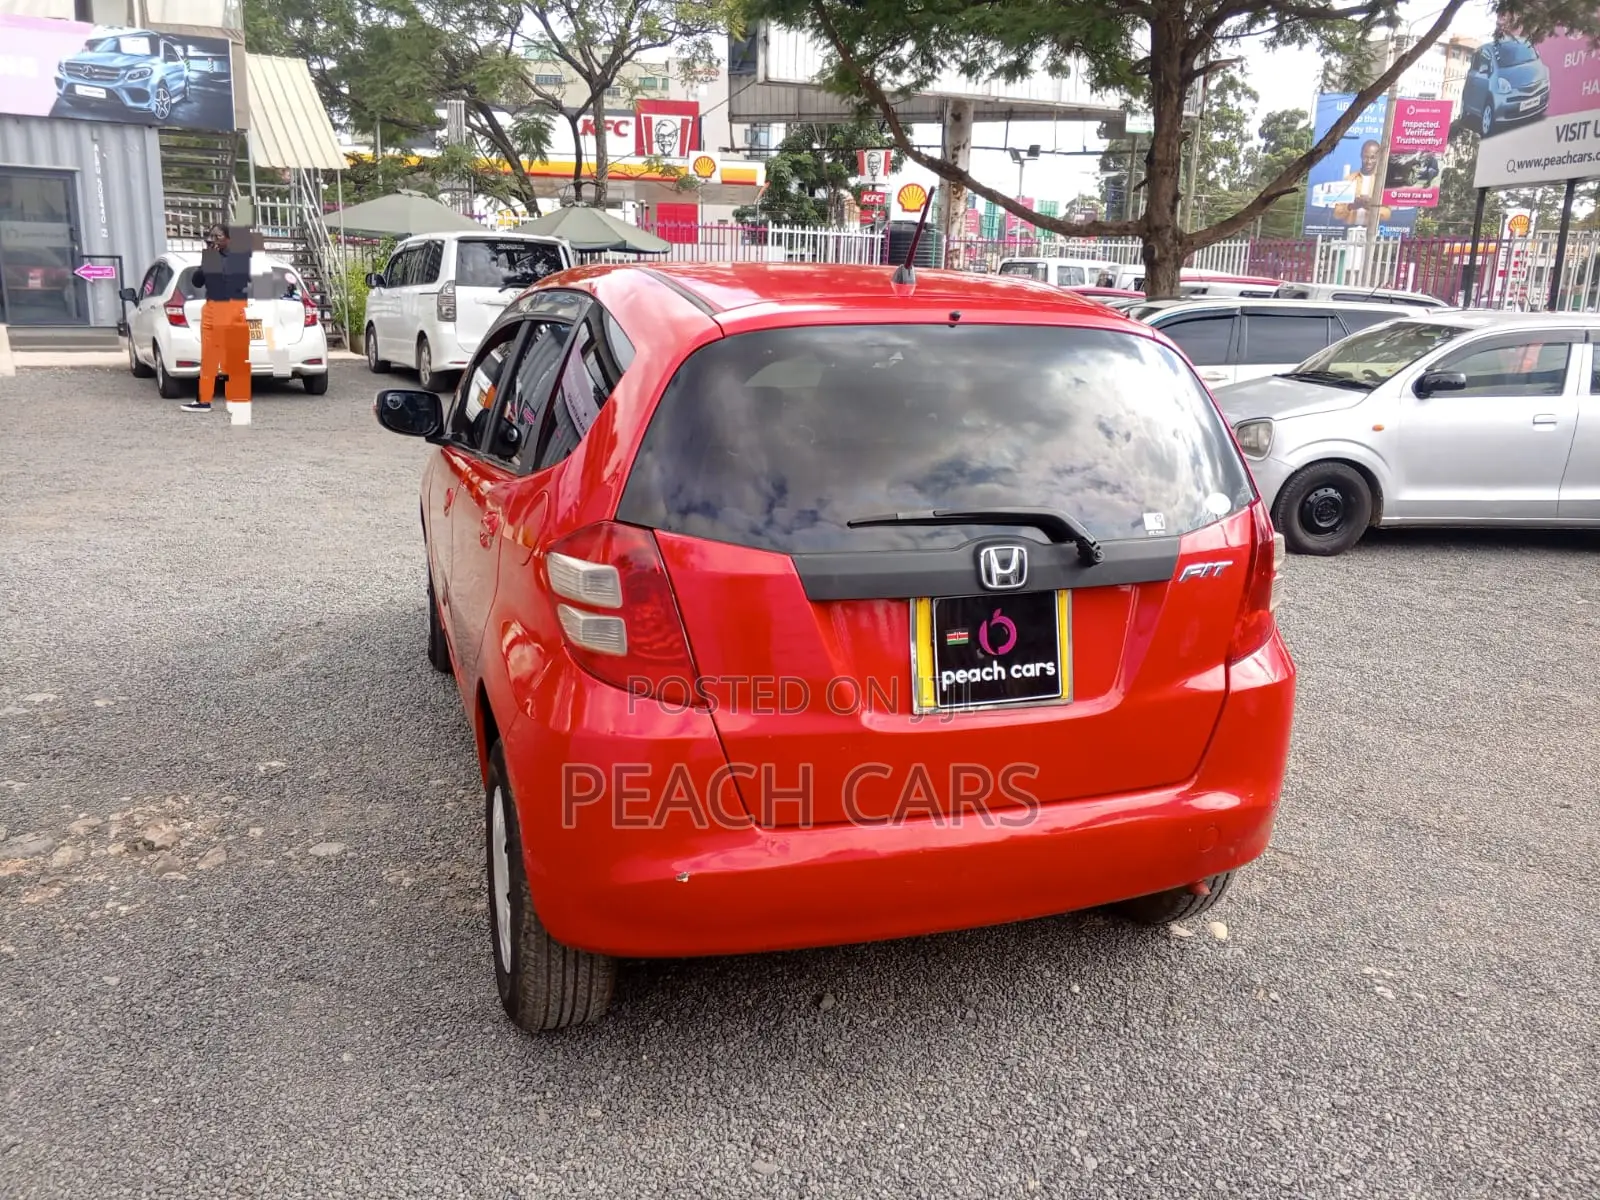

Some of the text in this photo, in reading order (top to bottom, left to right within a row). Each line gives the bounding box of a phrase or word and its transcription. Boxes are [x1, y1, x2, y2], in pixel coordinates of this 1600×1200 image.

[1564, 49, 1587, 68] BUY
[578, 118, 630, 138] KFC
[1402, 120, 1441, 129] Inspected.
[1405, 128, 1436, 137] Verified.
[1556, 120, 1591, 143] VISIT
[1395, 136, 1443, 146] Trustworthy!
[862, 194, 884, 203] KFC
[1178, 560, 1234, 583] FIT
[941, 660, 1056, 692] peach cars
